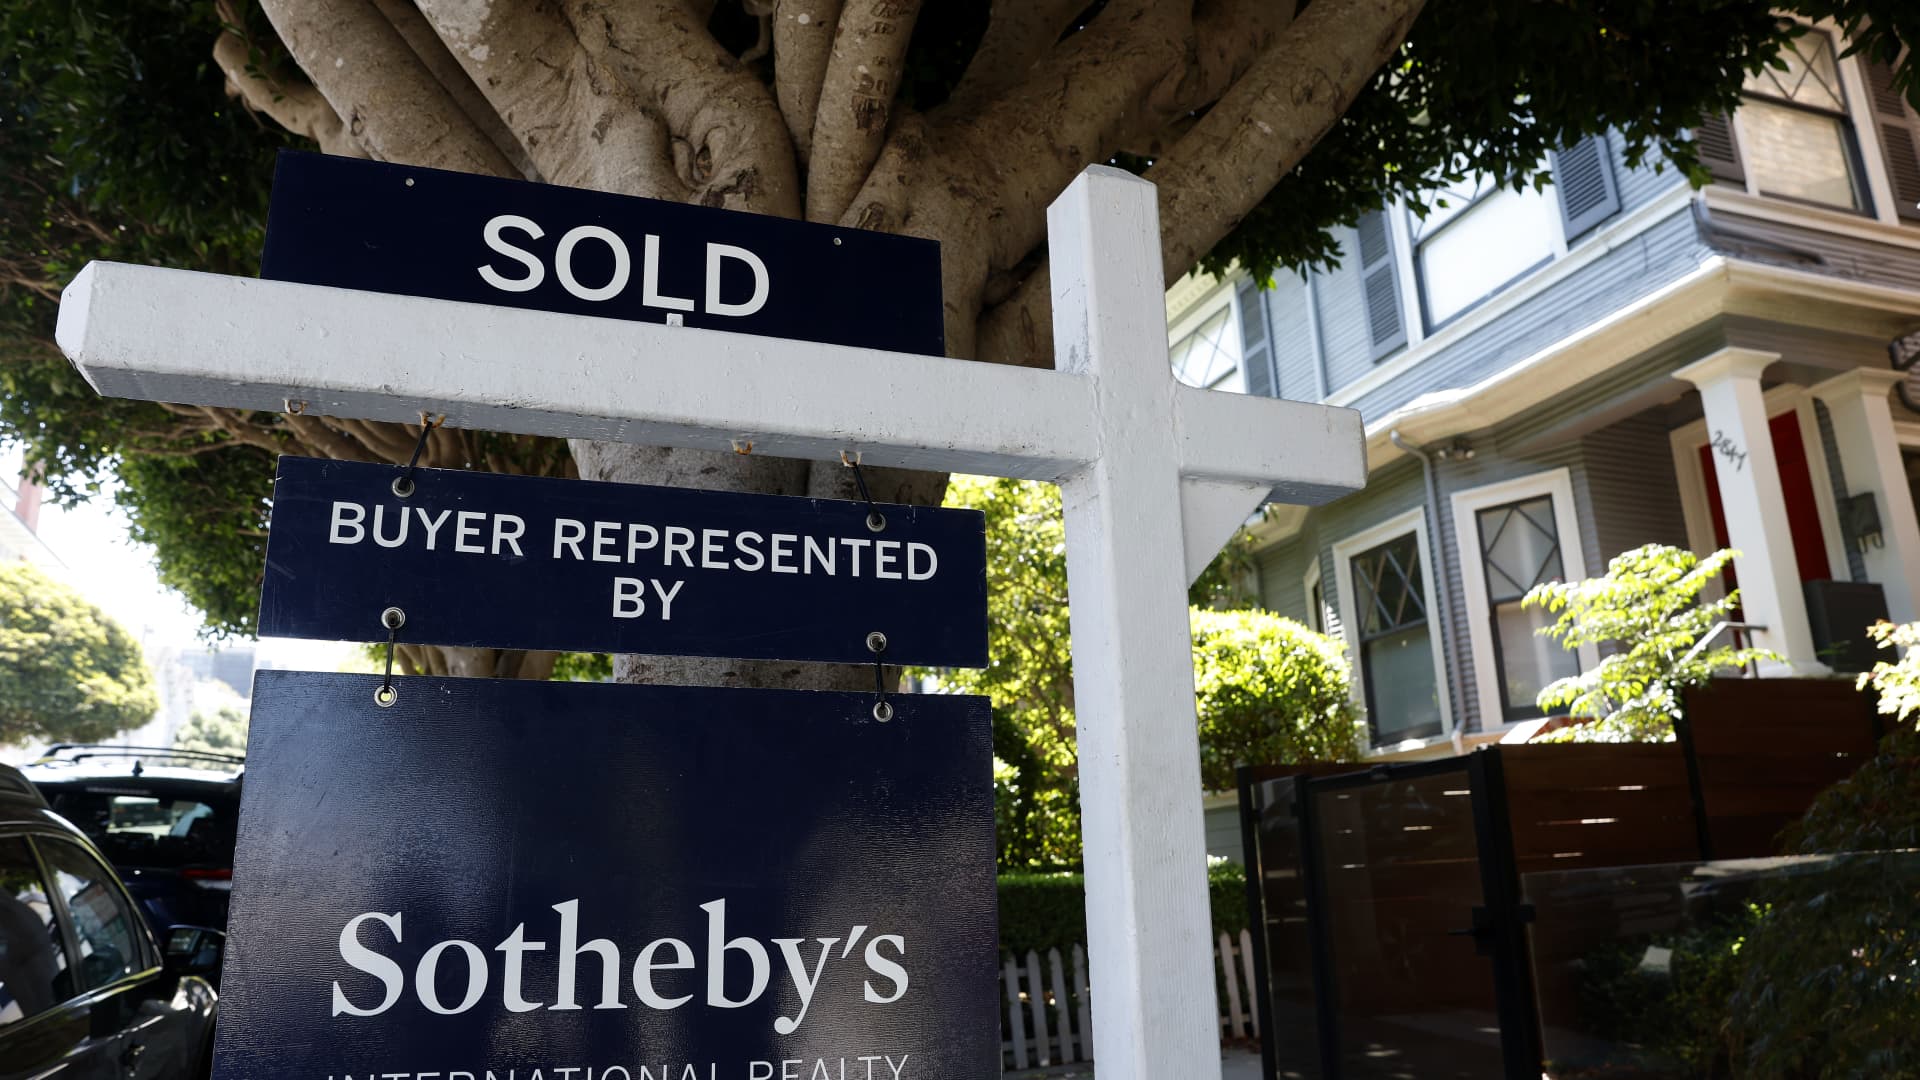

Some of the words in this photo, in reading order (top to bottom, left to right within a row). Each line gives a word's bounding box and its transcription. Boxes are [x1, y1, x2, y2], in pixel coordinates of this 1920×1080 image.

[477, 214, 770, 317] SOLD
[329, 501, 526, 557] BUYER
[553, 518, 938, 581] REPRESENTED
[612, 576, 685, 621] BY
[332, 897, 909, 1035] Sotheby's
